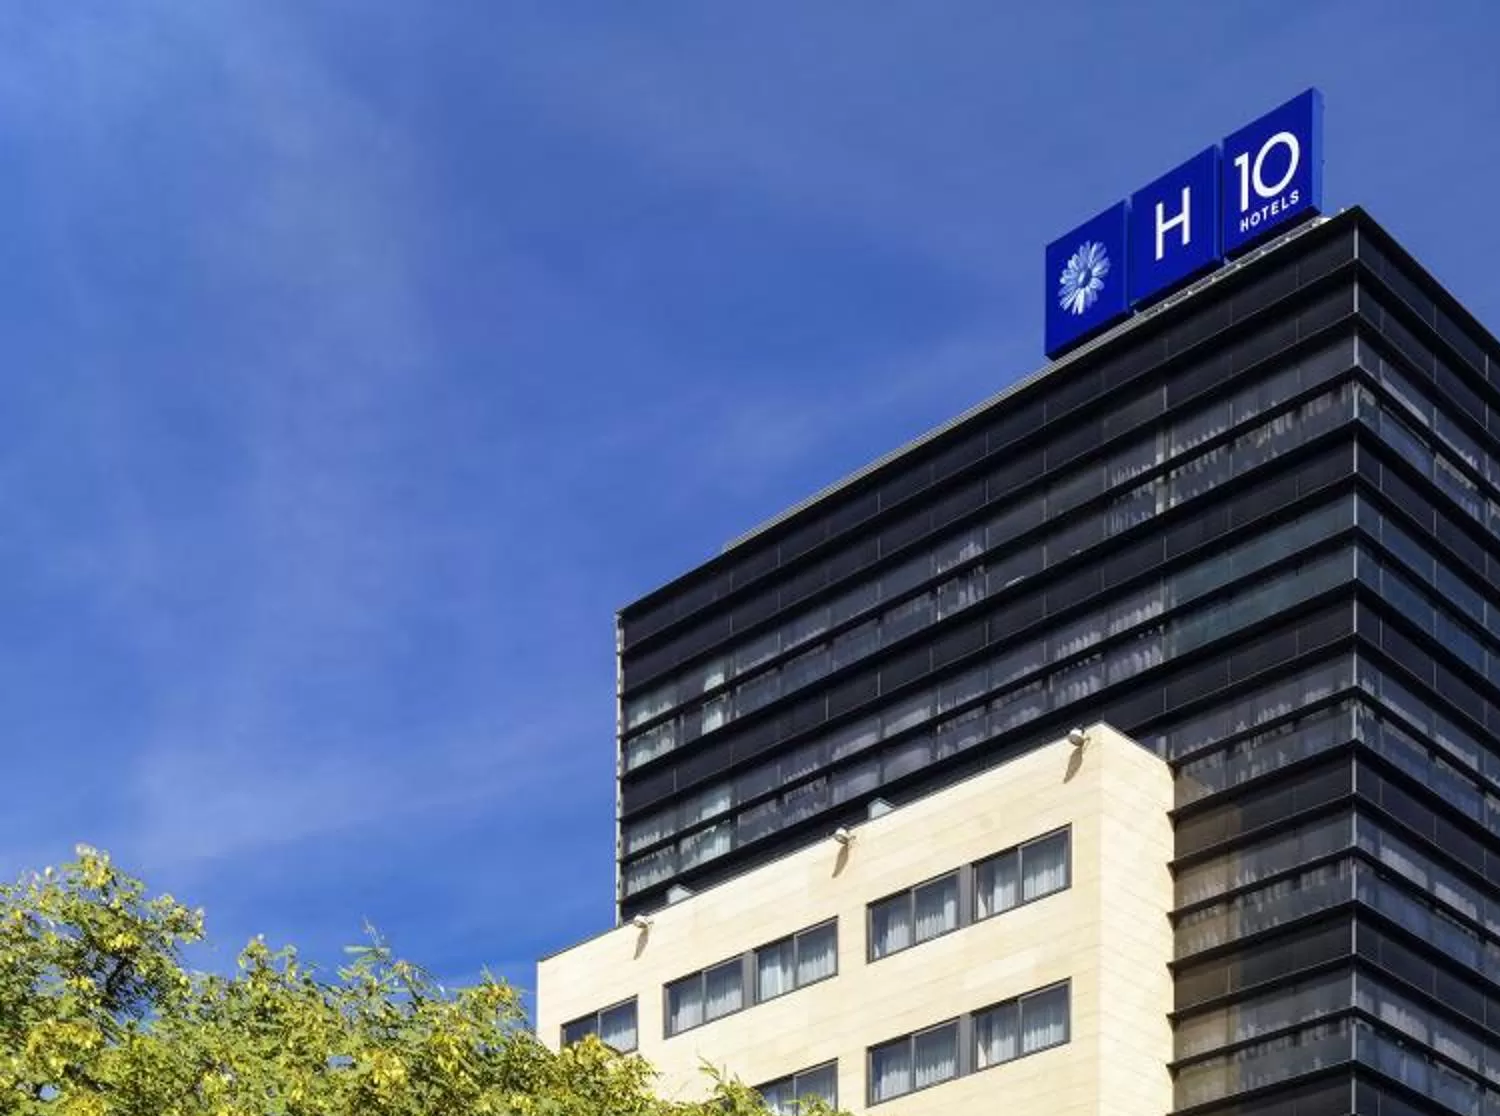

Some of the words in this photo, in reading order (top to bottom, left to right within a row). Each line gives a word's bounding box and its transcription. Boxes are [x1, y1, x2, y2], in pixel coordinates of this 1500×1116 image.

[1155, 186, 1191, 261] H
[1234, 131, 1301, 212] 10
[1239, 189, 1301, 233] HOTELS
